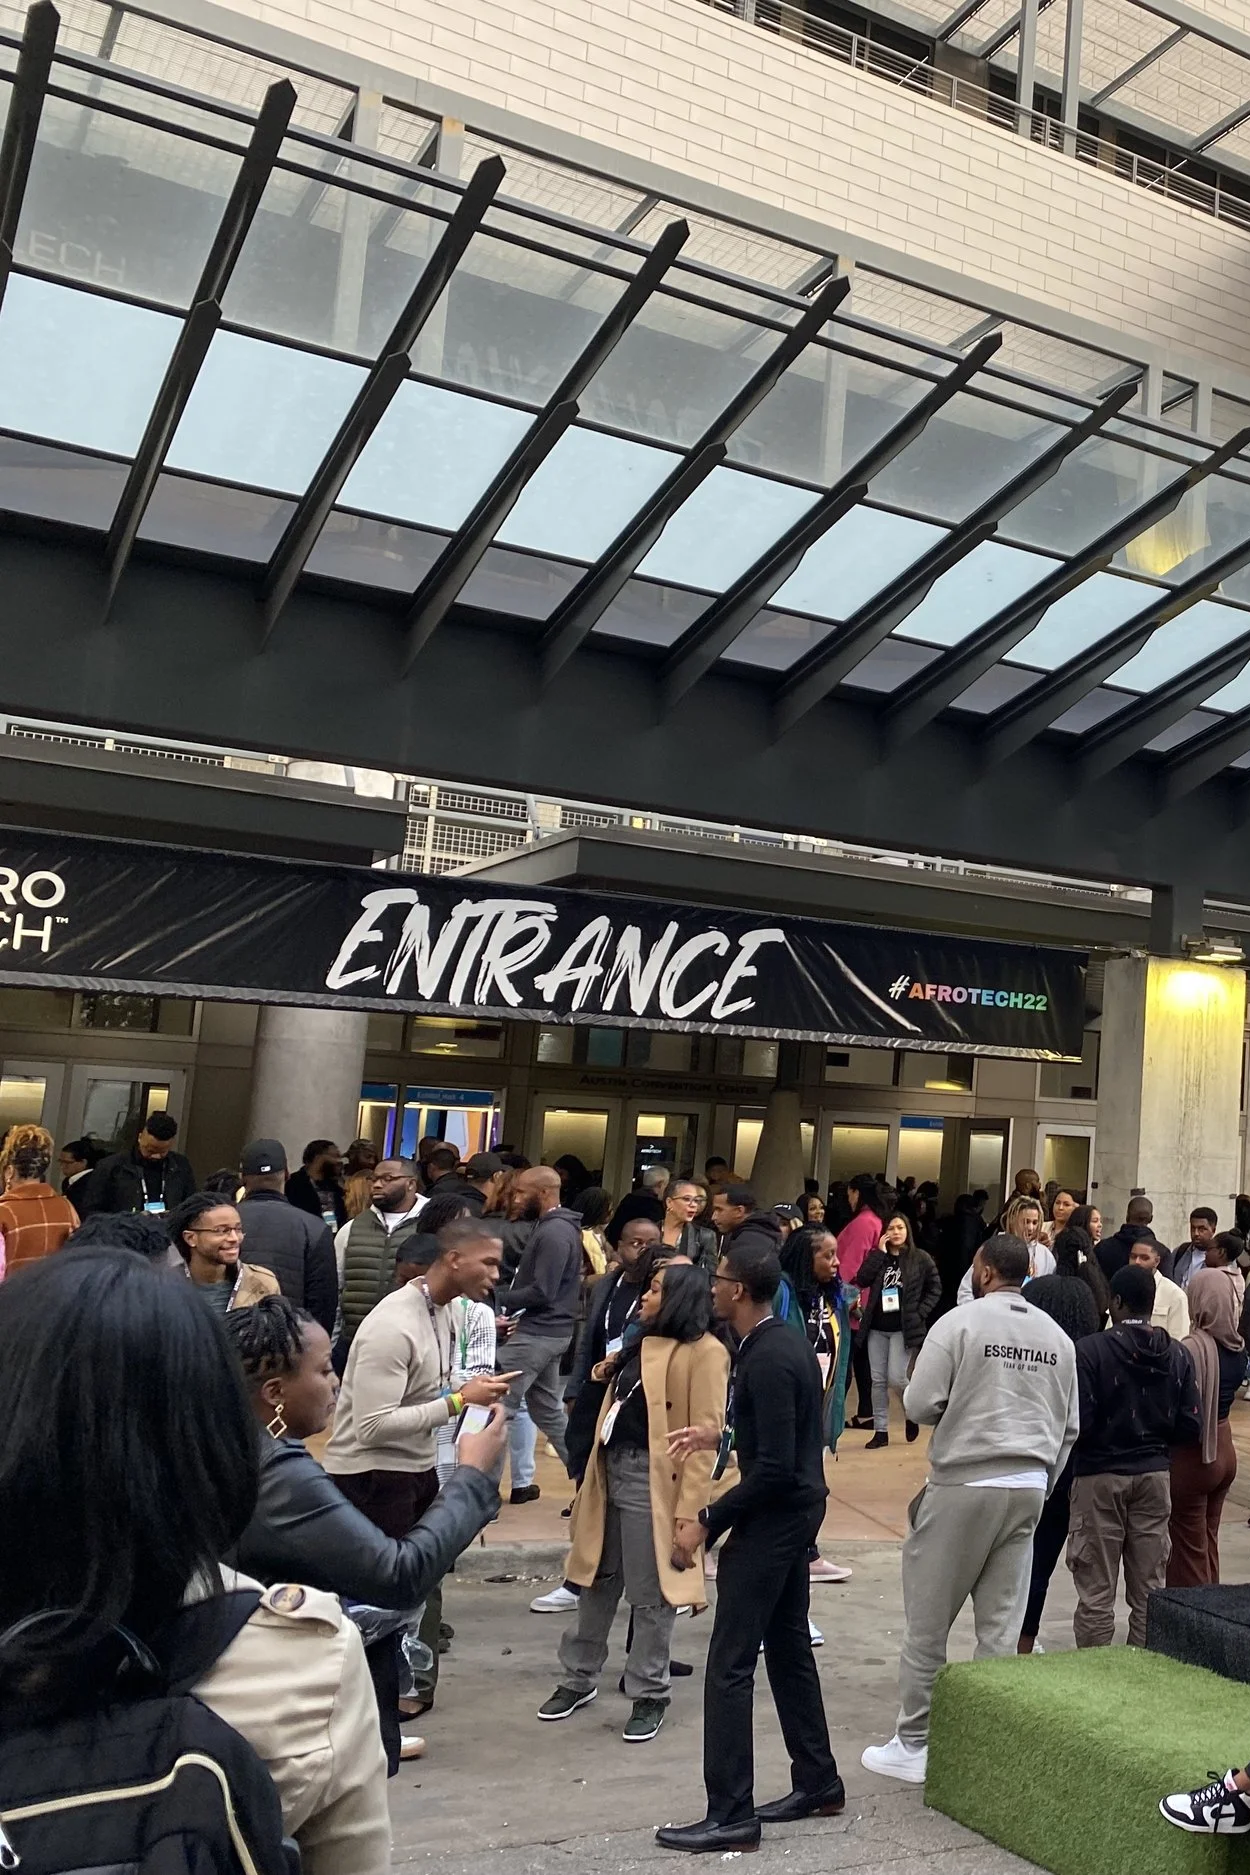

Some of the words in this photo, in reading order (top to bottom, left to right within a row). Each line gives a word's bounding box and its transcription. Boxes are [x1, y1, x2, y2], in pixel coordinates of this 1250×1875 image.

[325, 887, 786, 1019] ENTRANCE
[888, 974, 1048, 1011] #AFROTECH22
[984, 1344, 1058, 1366] ESSENTIALS
